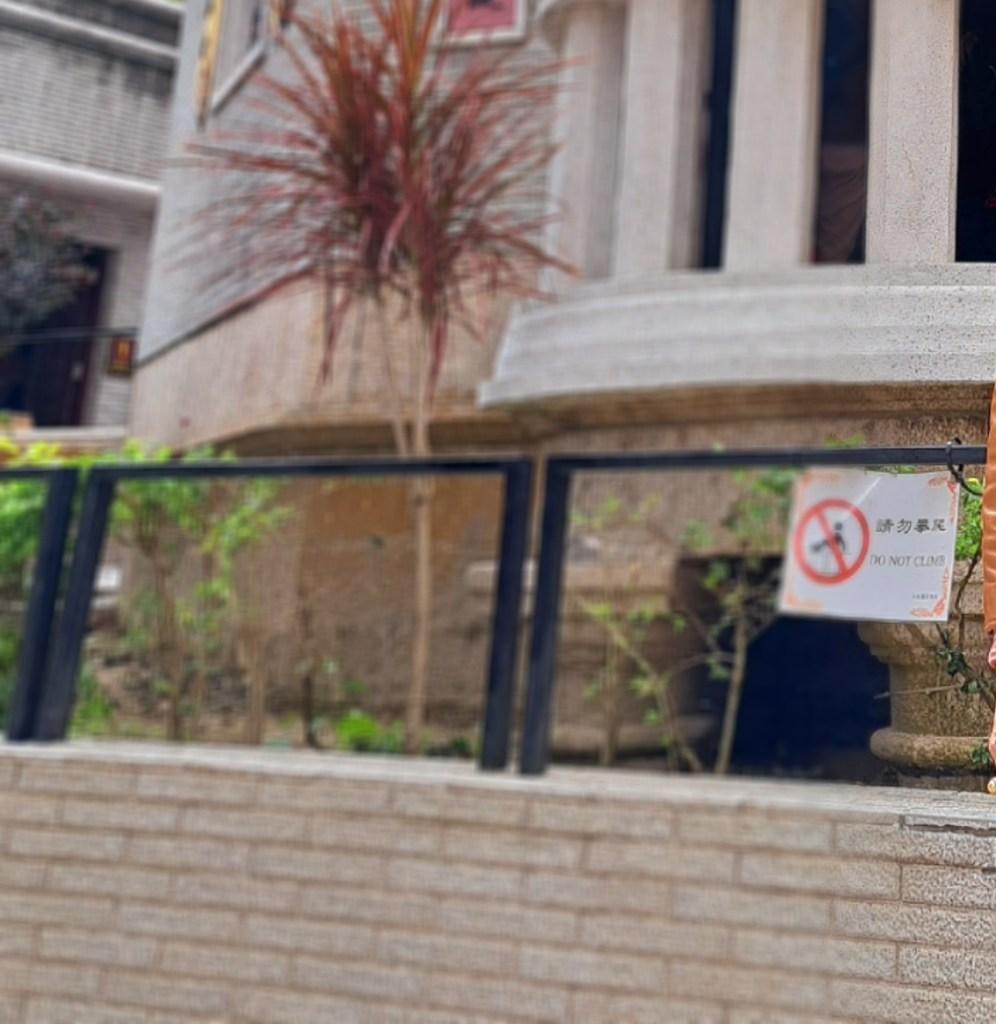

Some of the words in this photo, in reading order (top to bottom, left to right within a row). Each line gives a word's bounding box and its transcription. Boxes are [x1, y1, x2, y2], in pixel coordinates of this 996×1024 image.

[870, 554, 886, 568] DO
[889, 554, 912, 568] NOT
[913, 554, 946, 568] CLIMB
